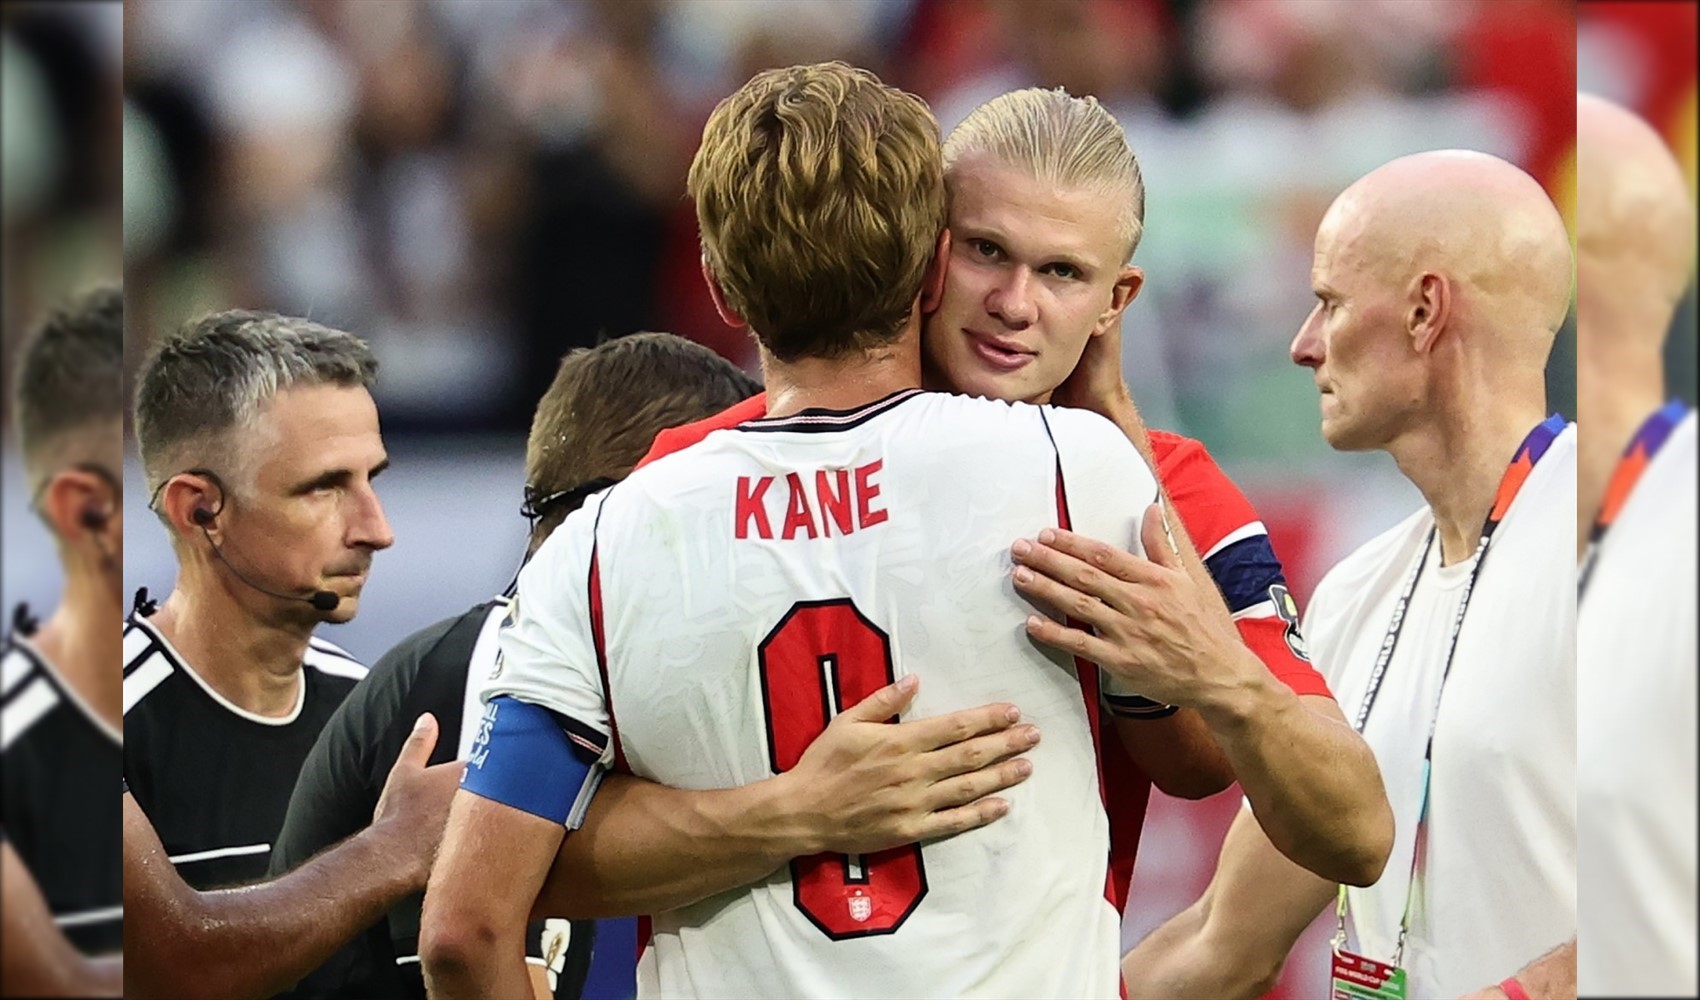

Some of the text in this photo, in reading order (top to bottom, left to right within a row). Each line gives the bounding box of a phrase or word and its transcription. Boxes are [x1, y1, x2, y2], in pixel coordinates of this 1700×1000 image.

[735, 457, 889, 540] KANE
[1365, 633, 1396, 694] WORLD
[1389, 600, 1406, 633] CUP
